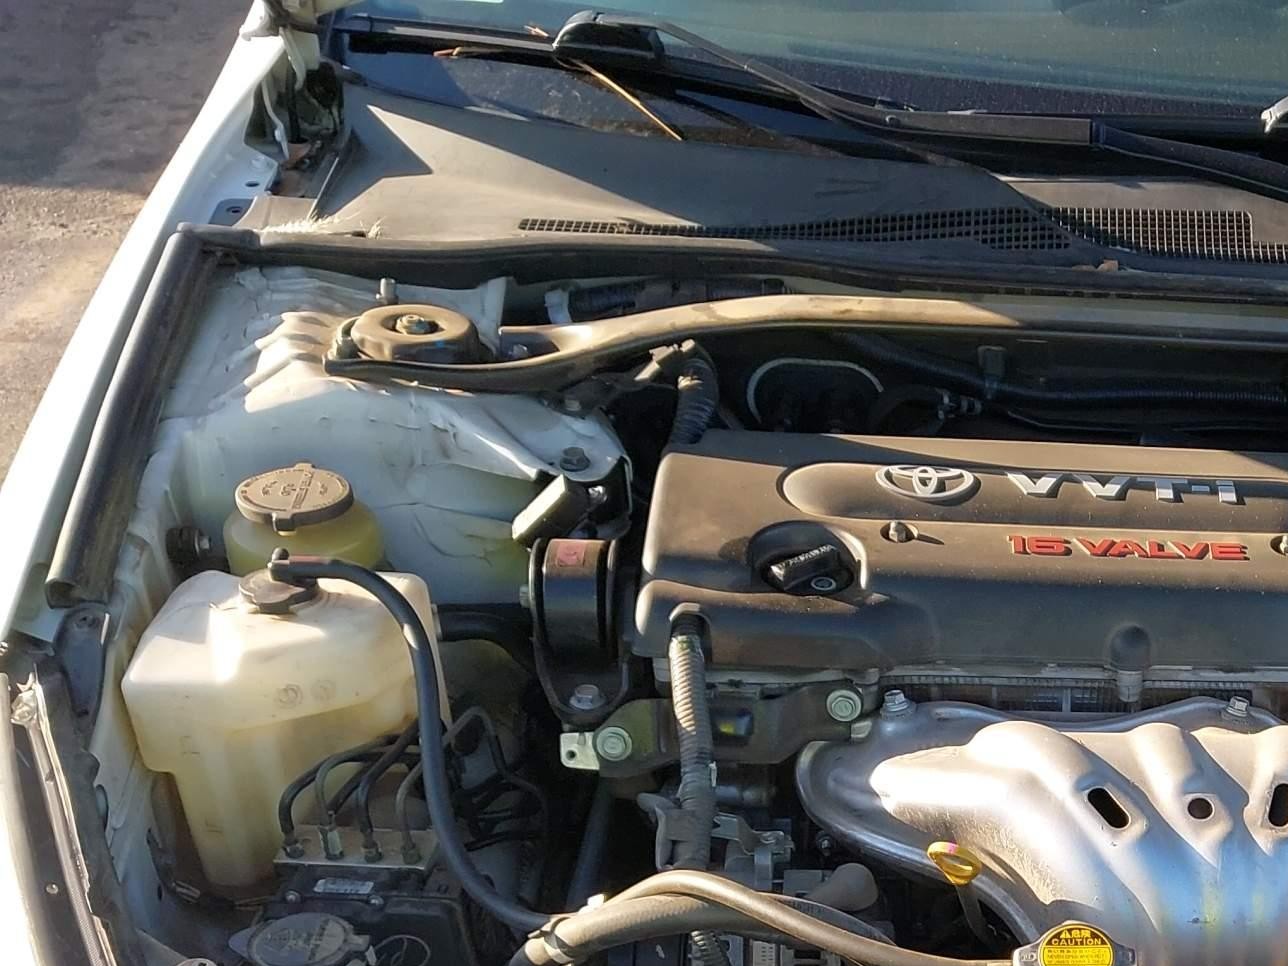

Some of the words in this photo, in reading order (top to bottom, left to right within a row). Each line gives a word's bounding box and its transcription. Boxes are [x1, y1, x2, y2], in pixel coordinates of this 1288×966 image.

[1007, 535, 1071, 556] 16
[1074, 537, 1248, 561] VALVE
[1051, 938, 1102, 946] CAUTION
